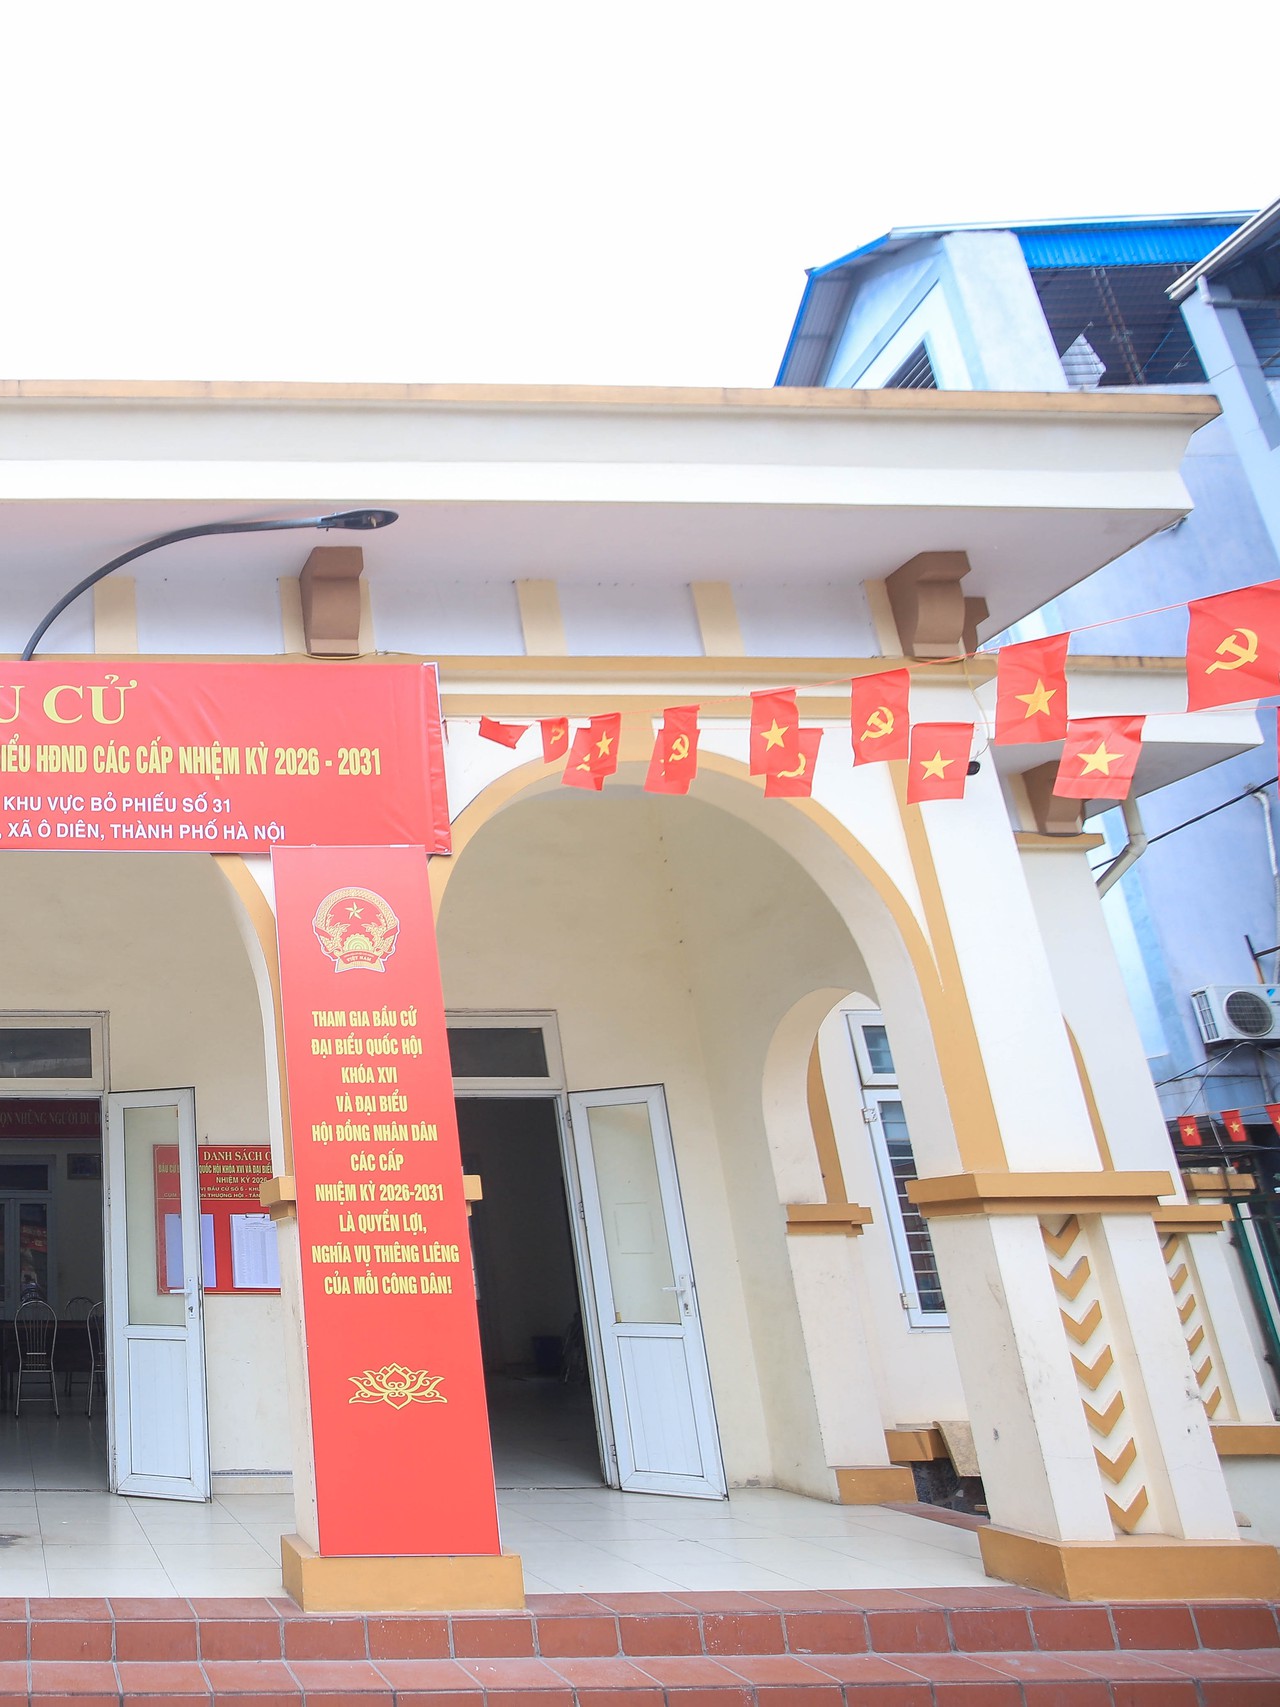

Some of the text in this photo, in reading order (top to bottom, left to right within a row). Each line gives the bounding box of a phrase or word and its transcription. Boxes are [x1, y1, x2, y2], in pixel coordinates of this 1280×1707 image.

[43, 675, 137, 724] CỬ
[37, 745, 87, 772] HĐND
[94, 740, 130, 773] CÁC
[136, 736, 173, 773] CẤP
[179, 741, 239, 780] NHIỆM
[246, 742, 268, 774] KỲ
[275, 748, 319, 775] 2026
[338, 748, 380, 775] 2031
[4, 797, 41, 810] KHU
[48, 795, 84, 814] VỰC
[91, 792, 116, 812] BỎ
[123, 792, 176, 812] PHIẾU
[183, 792, 207, 812] SỐ
[213, 799, 229, 812] 31
[8, 820, 32, 837] XÃ
[38, 819, 50, 837] Ô
[57, 820, 104, 840] DIÊN,
[110, 820, 172, 838] THÀNH
[180, 819, 217, 839] PHỐ
[224, 822, 248, 839] HÀ
[254, 822, 287, 841] NỘI
[312, 1006, 417, 1026] THAM GIA BẦU CỬ
[311, 1032, 422, 1058] ĐẠI BIỂU QUỐC HỘI
[342, 1064, 397, 1083] KHÓA XVI
[336, 1089, 407, 1115] VÀ ĐẠI BIỂU
[312, 1119, 437, 1145] HỘI ĐỒNG NHÂN DÂN
[204, 1151, 232, 1161] DANH
[234, 1149, 263, 1161] SÁCH
[351, 1148, 403, 1171] CÁC CẤP
[316, 1181, 443, 1205] NHIỆM KỲ 2026-2031
[339, 1209, 426, 1235] LÀ QUYỀN LỢI,
[312, 1241, 459, 1266] NGHĨA VỤ THIÊNG LIÊNG
[325, 1270, 452, 1294] CỦA MỖI CÔNG DÂN!
